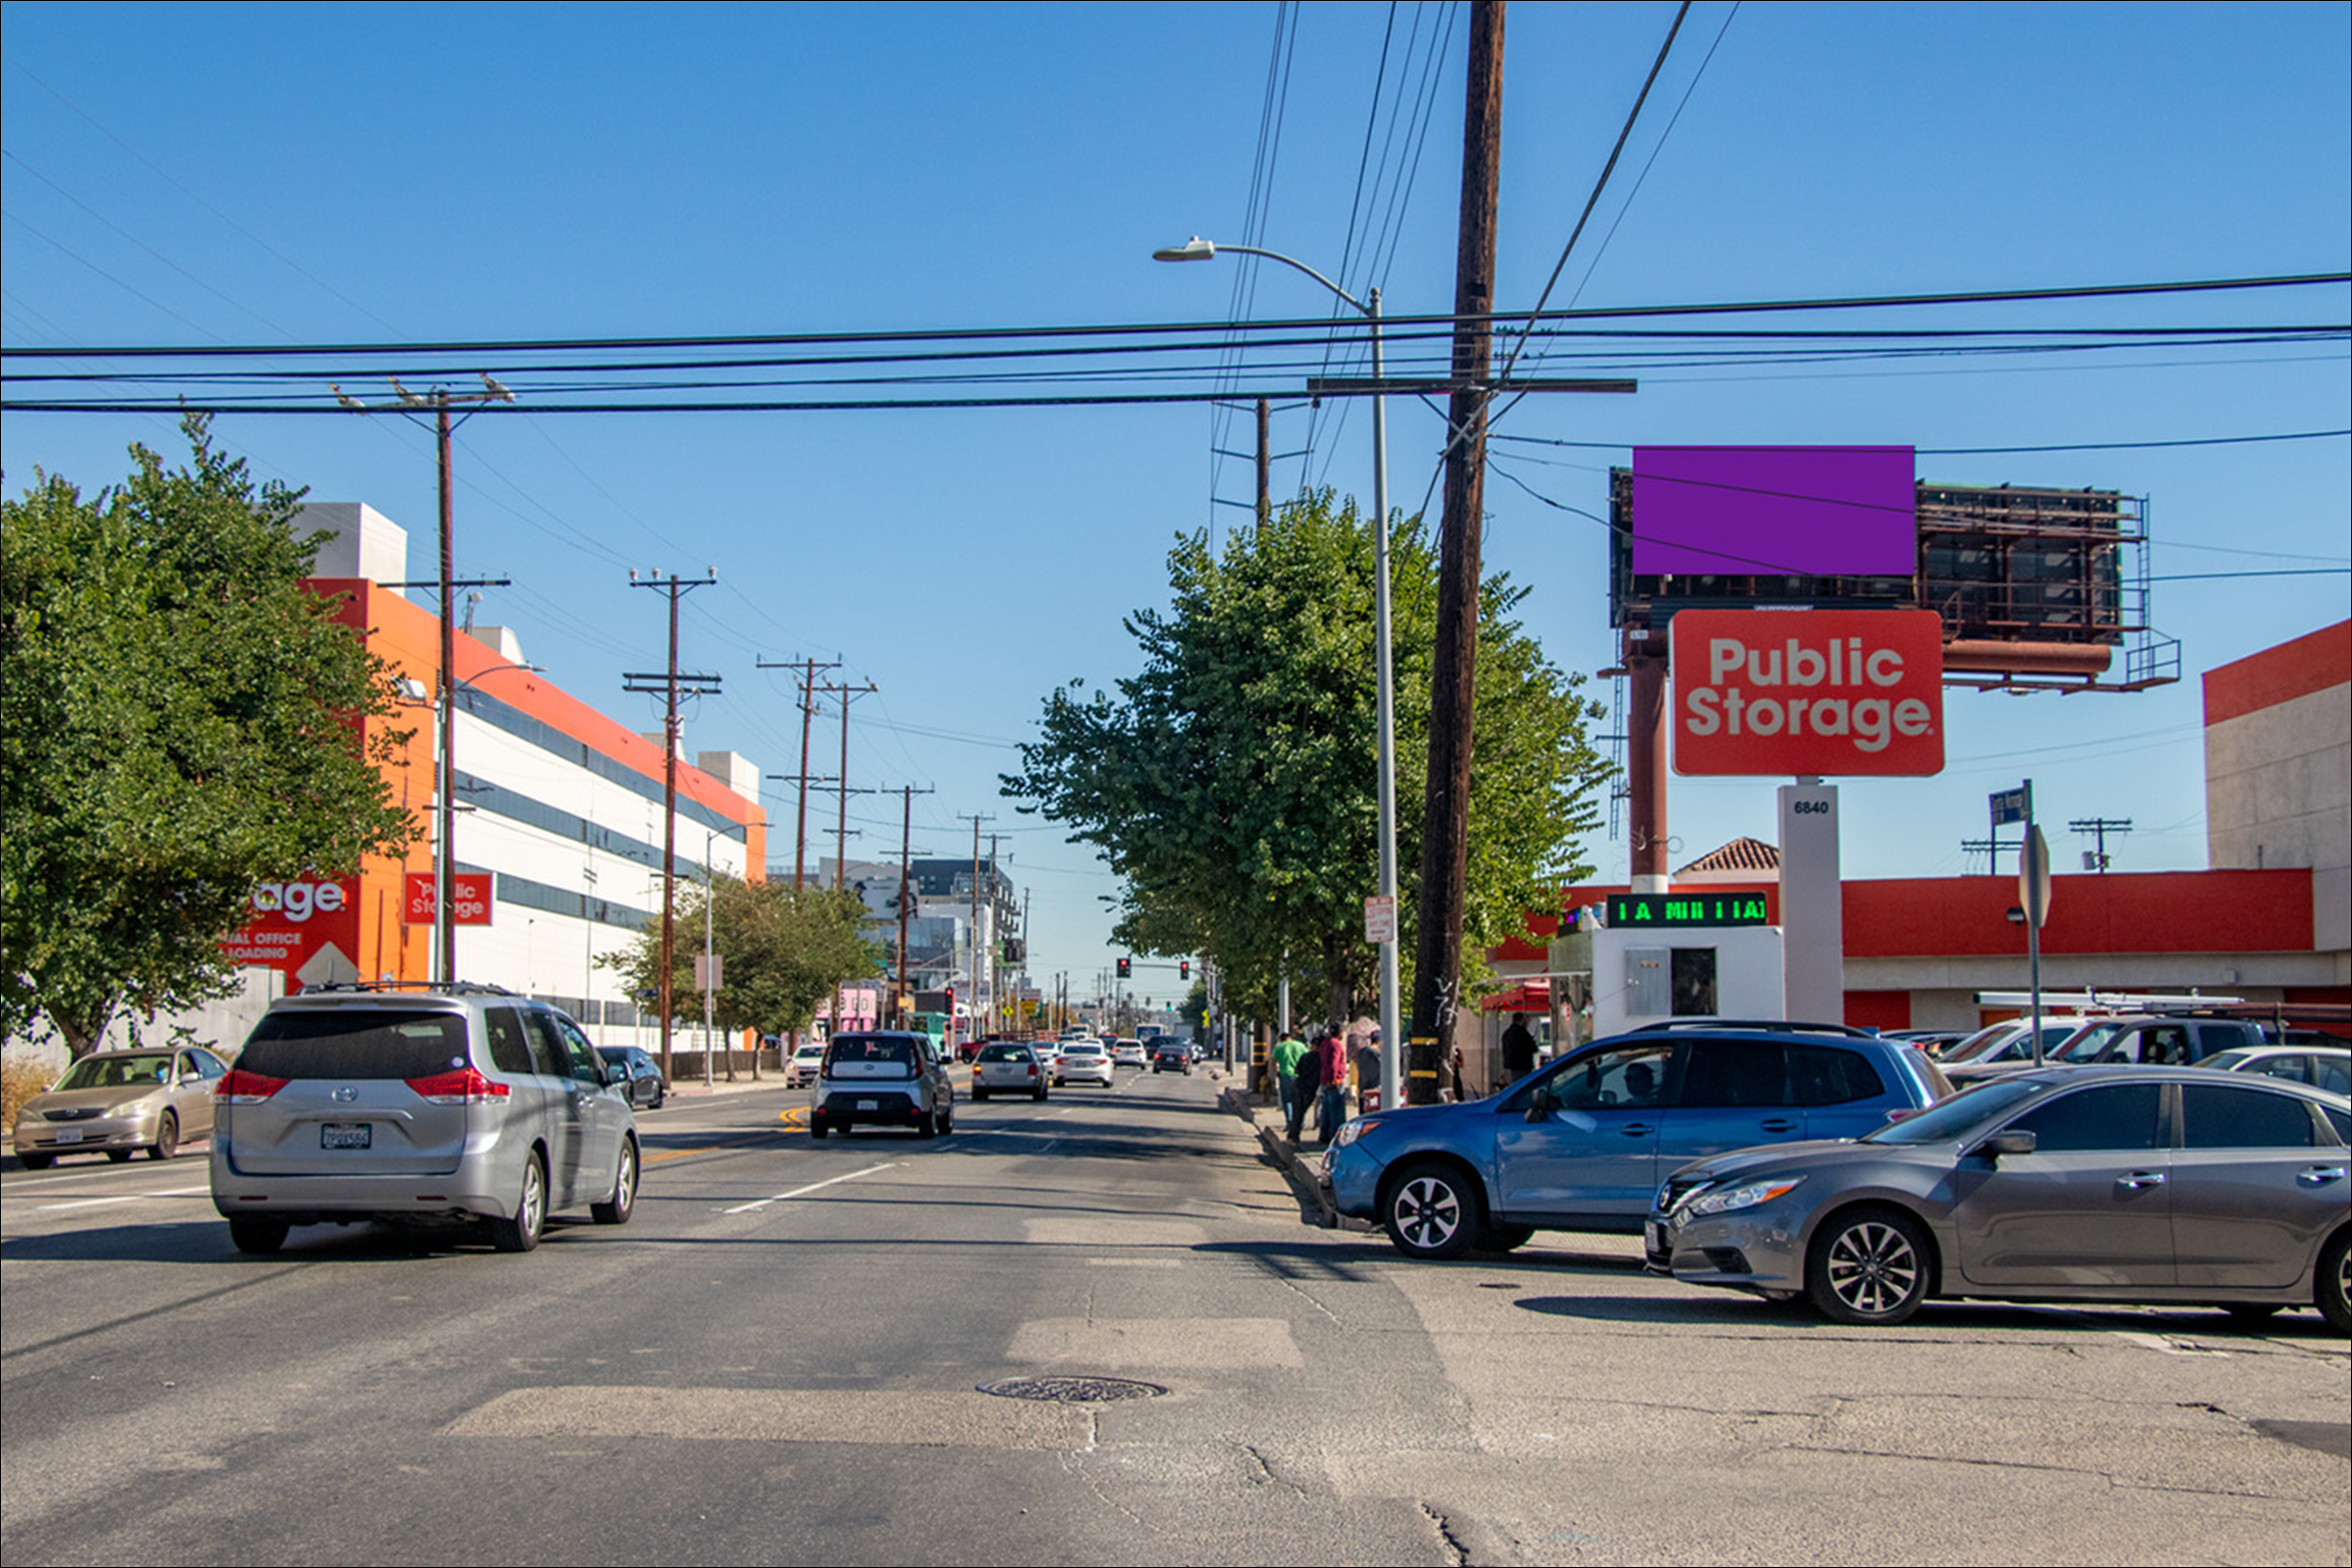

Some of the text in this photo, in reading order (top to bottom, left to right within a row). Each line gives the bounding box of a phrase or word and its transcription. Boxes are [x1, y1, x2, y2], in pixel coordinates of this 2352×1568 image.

[1709, 637, 1905, 687] Public
[1686, 687, 1932, 753] Storage
[1793, 801, 1829, 814] 6840
[420, 883, 476, 899] Plic
[254, 932, 302, 945] OFFICE
